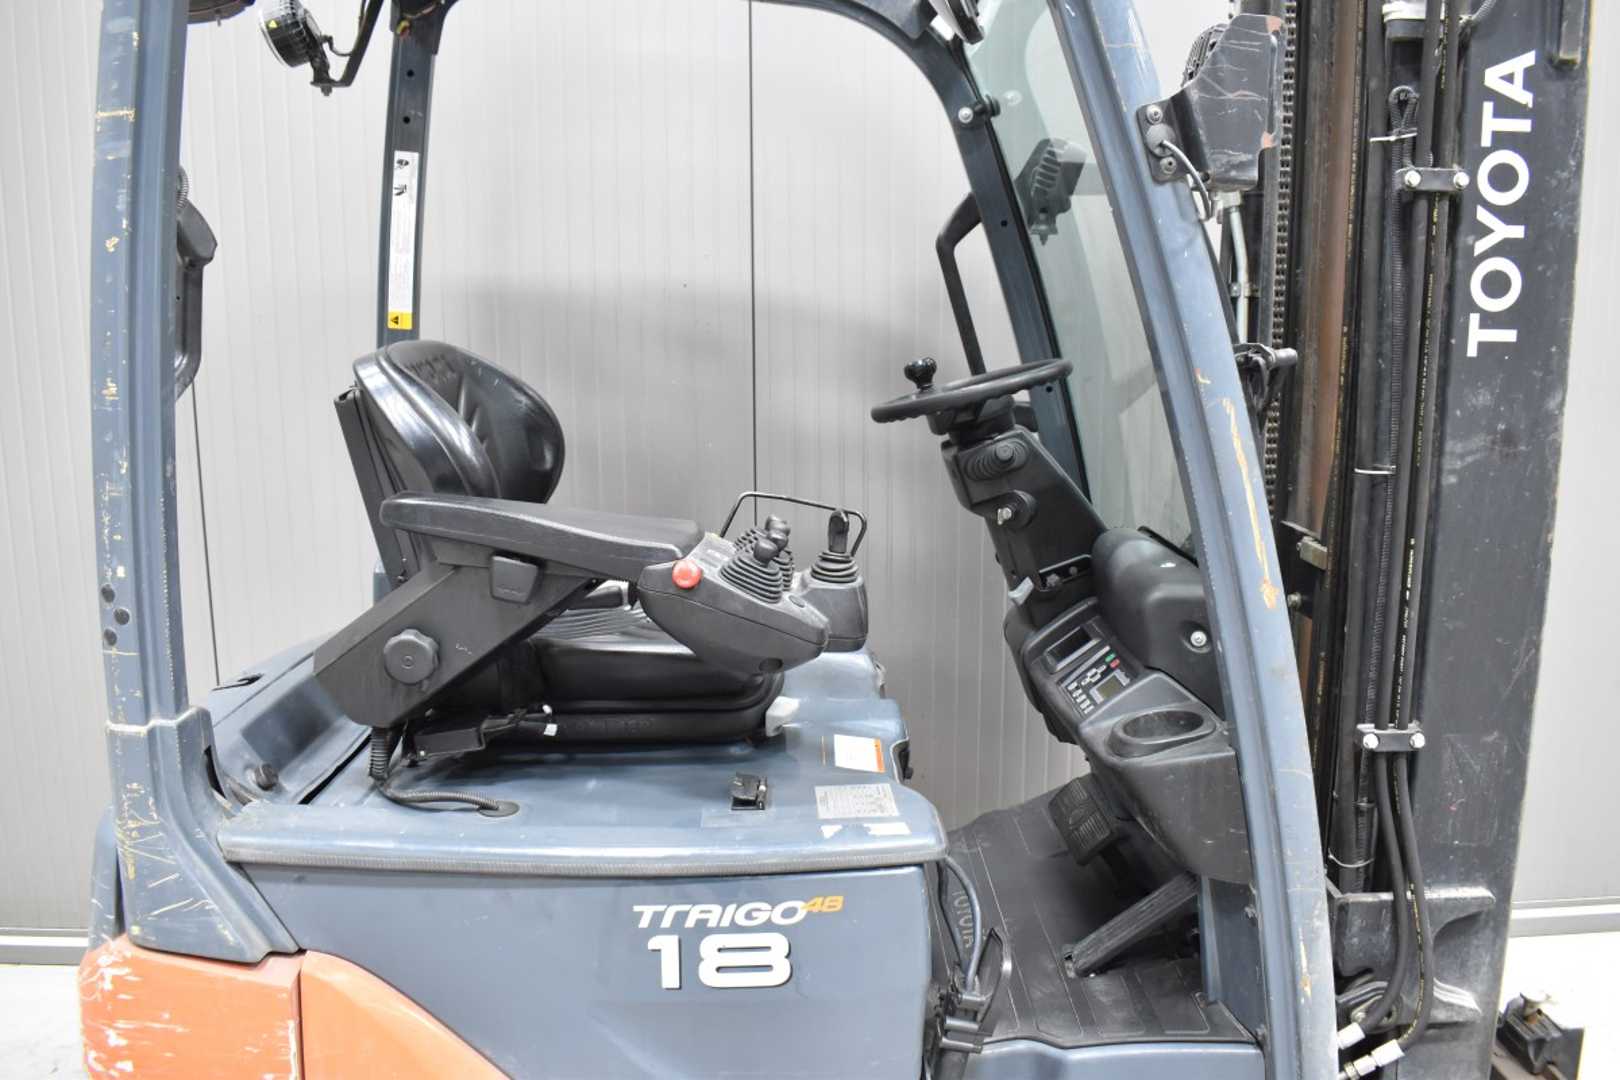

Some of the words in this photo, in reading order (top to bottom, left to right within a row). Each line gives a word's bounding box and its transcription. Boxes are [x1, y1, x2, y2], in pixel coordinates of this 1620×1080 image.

[1467, 50, 1536, 358] TOYOTA
[633, 900, 807, 929] TRAIGO
[647, 932, 793, 990] 18
